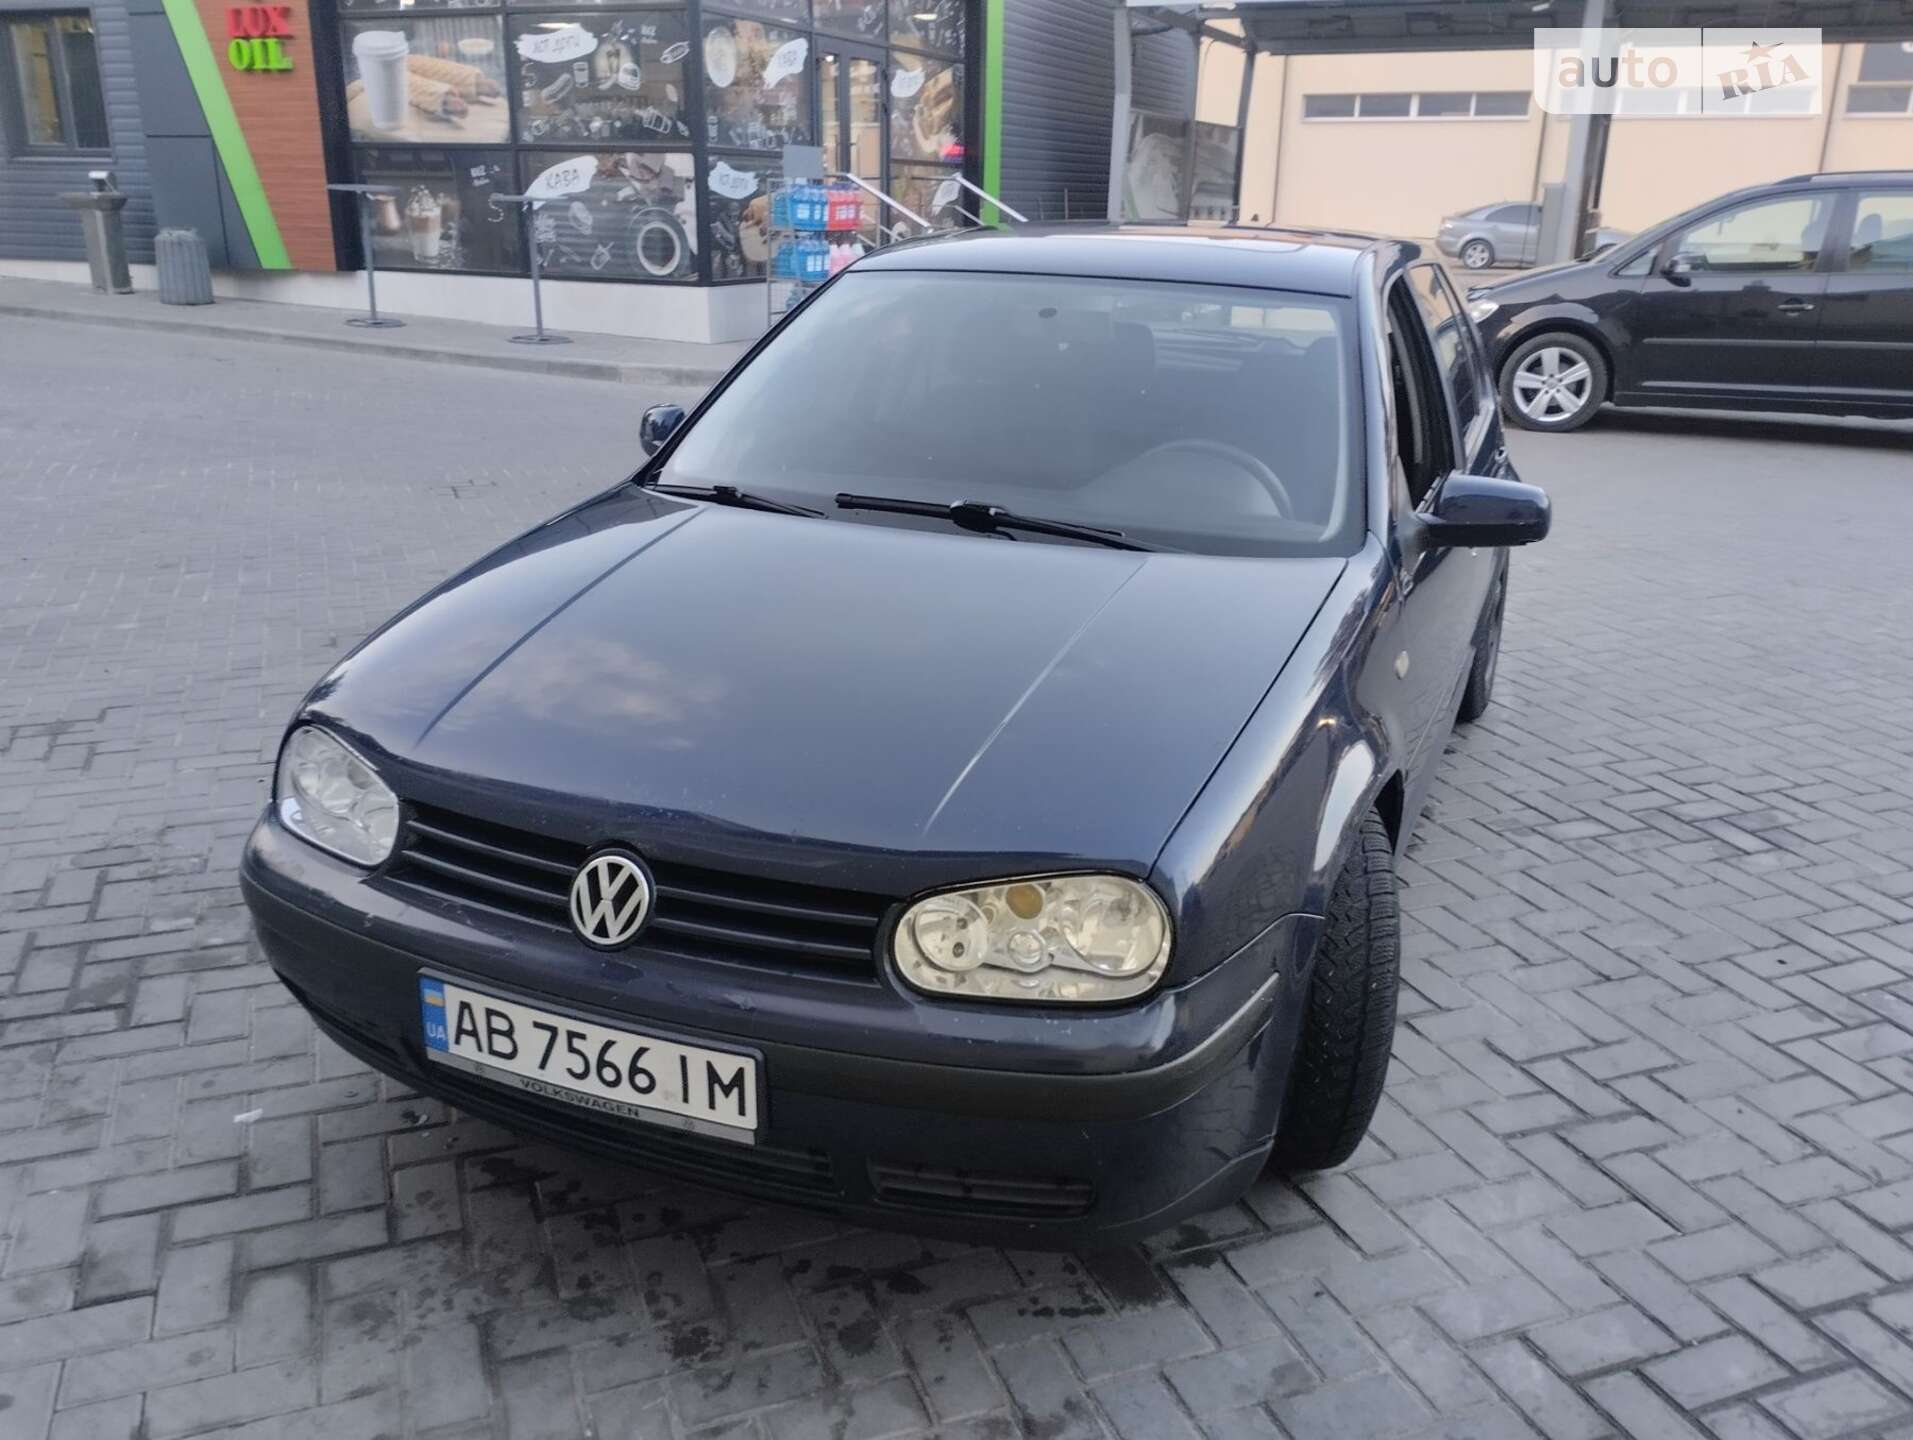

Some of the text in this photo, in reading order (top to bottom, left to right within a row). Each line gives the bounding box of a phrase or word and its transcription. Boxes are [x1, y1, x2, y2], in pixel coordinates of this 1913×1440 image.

[225, 6, 291, 37] LUX
[227, 38, 293, 70] OIL
[427, 1022, 446, 1039] UA
[454, 1000, 746, 1117] AB 7566 IM
[519, 1078, 640, 1118] VOLKSWAGEN
